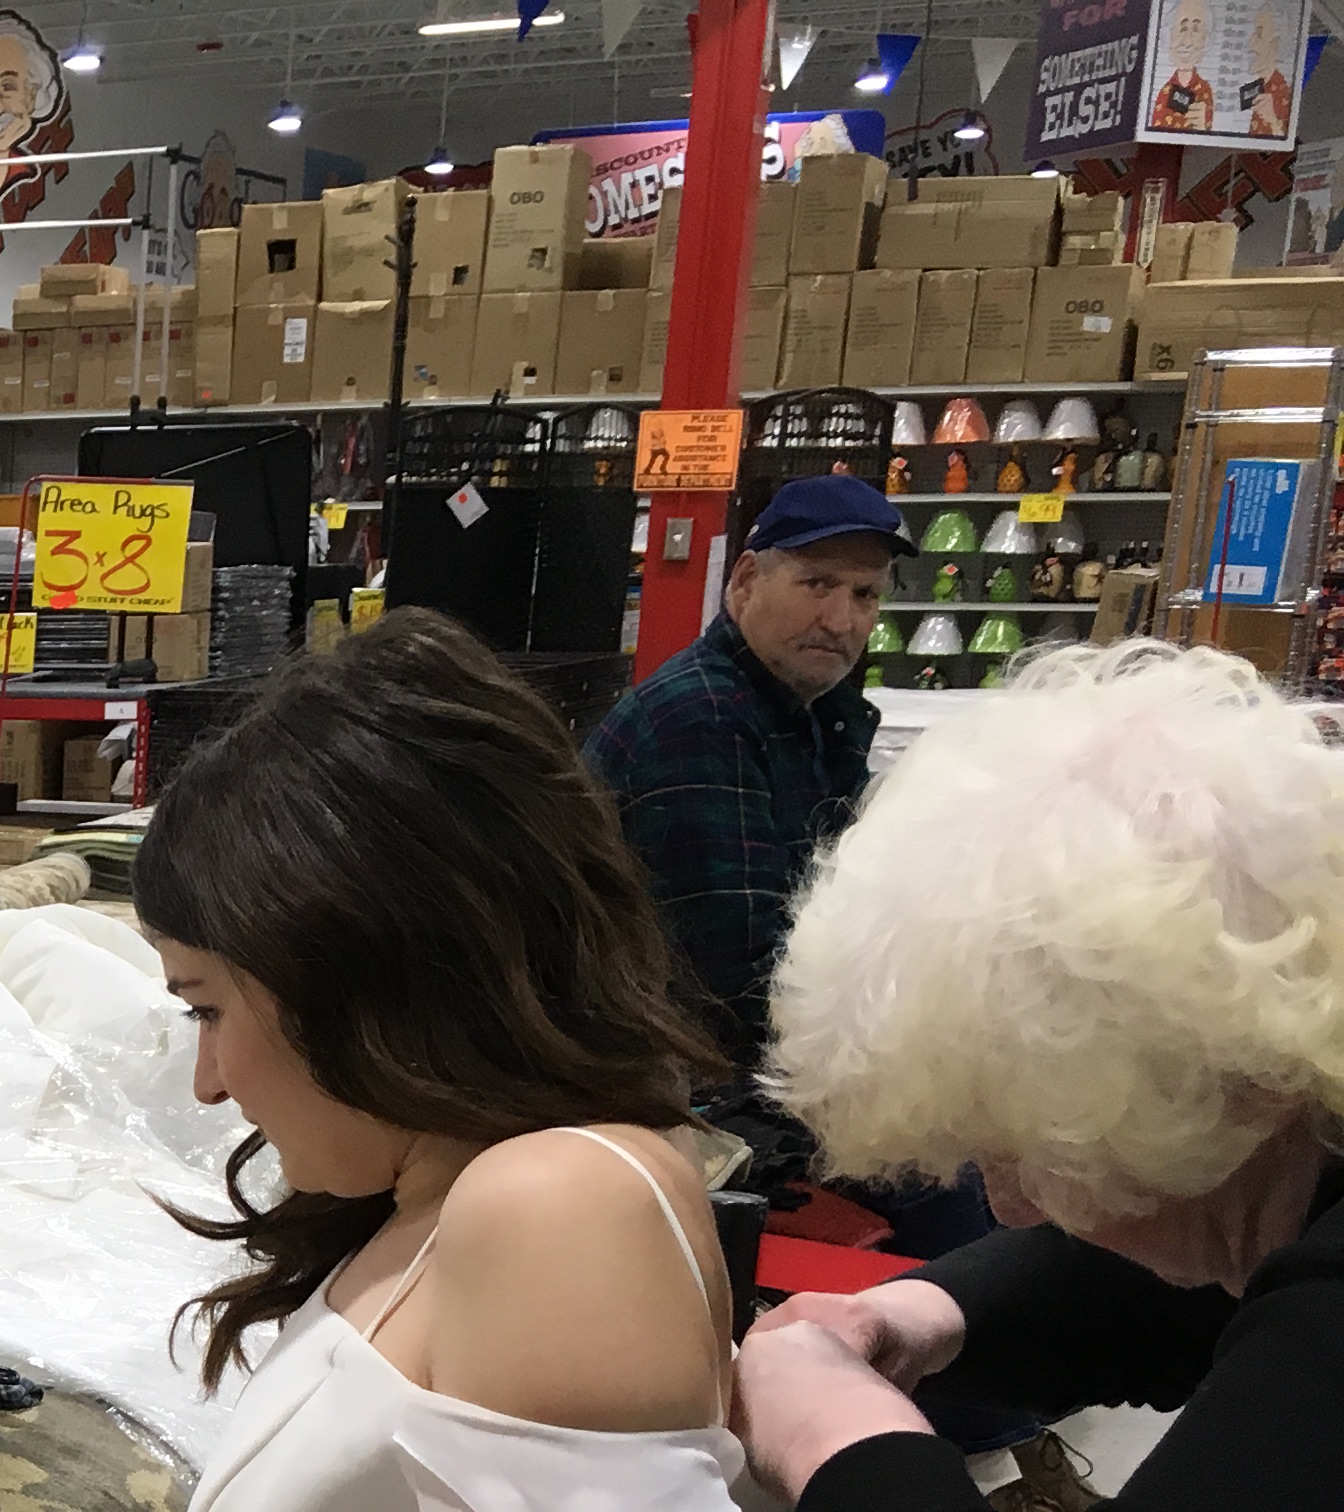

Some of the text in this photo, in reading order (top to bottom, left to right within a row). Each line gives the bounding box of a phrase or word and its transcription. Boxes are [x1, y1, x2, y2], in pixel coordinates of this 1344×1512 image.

[1037, 33, 1140, 95] SOMETHING
[1040, 77, 1127, 143] ELSE!
[691, 414, 730, 423] PLEASE
[675, 445, 727, 453] CUSTOMER
[697, 435, 718, 443] FOR
[41, 486, 170, 533] Area Rugs
